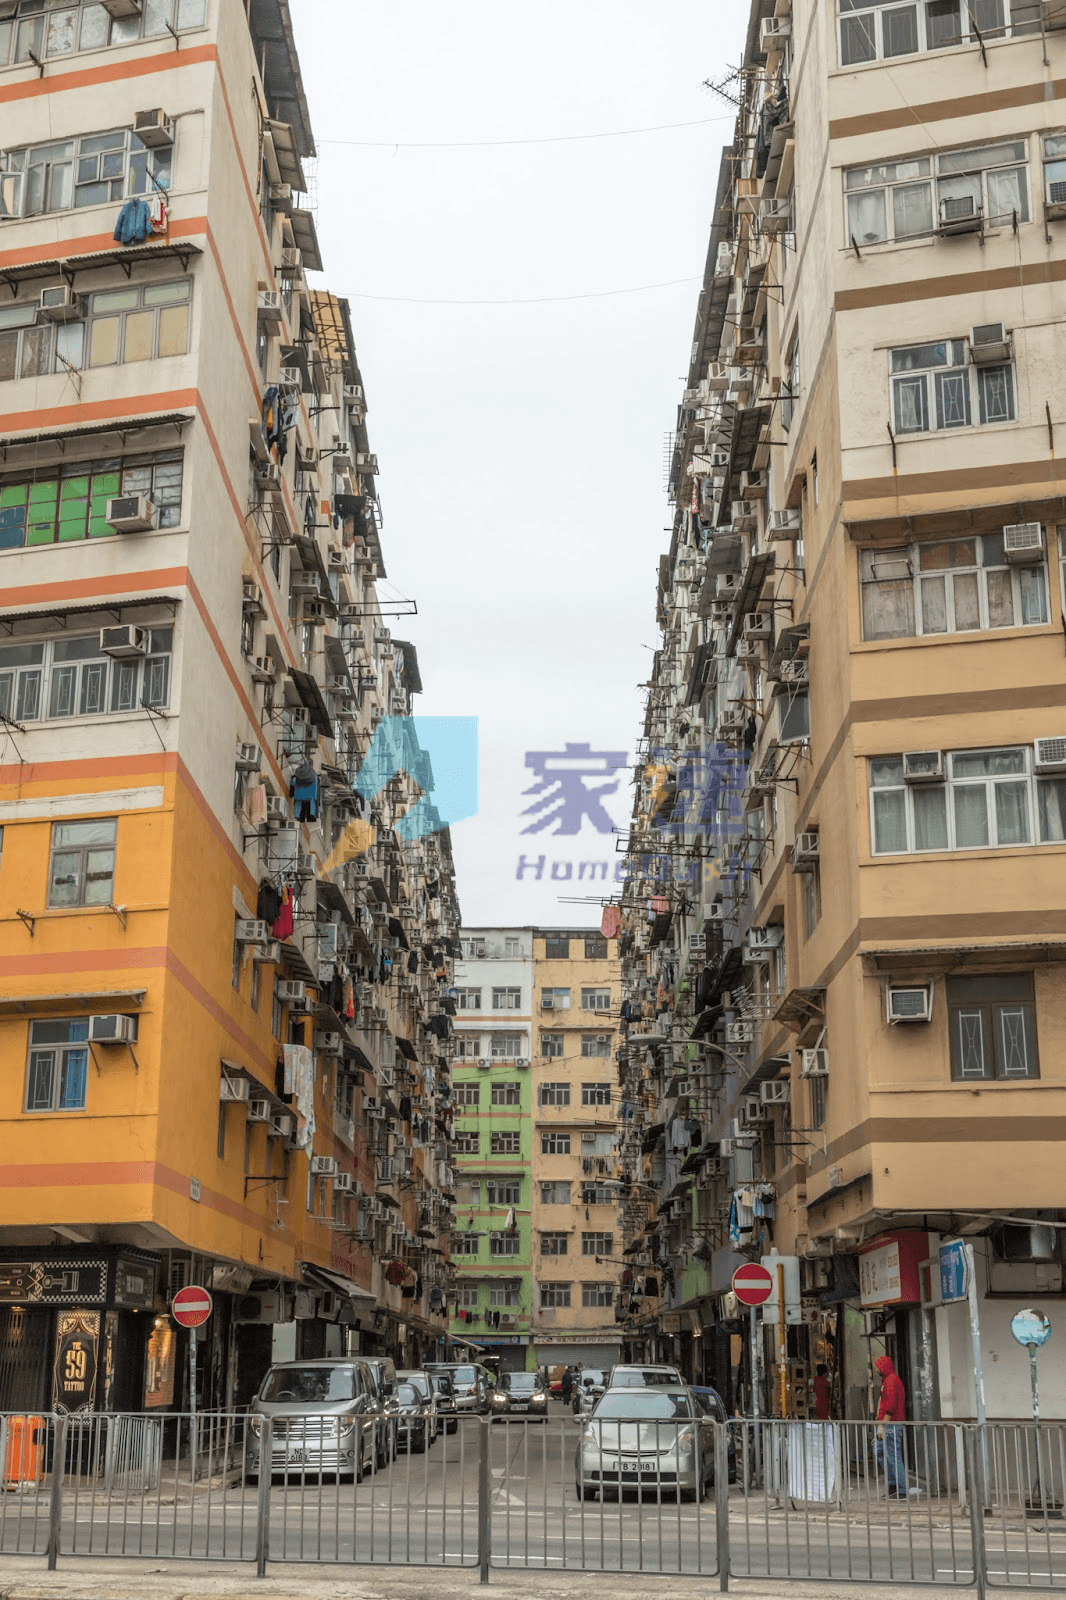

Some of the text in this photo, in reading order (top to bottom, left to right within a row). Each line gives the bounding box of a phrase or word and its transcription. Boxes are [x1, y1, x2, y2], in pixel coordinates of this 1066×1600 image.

[72, 1341, 82, 1350] THE
[65, 1350, 86, 1379] 59
[64, 1381, 85, 1391] TATTOO
[632, 1463, 651, 1471] 2018
